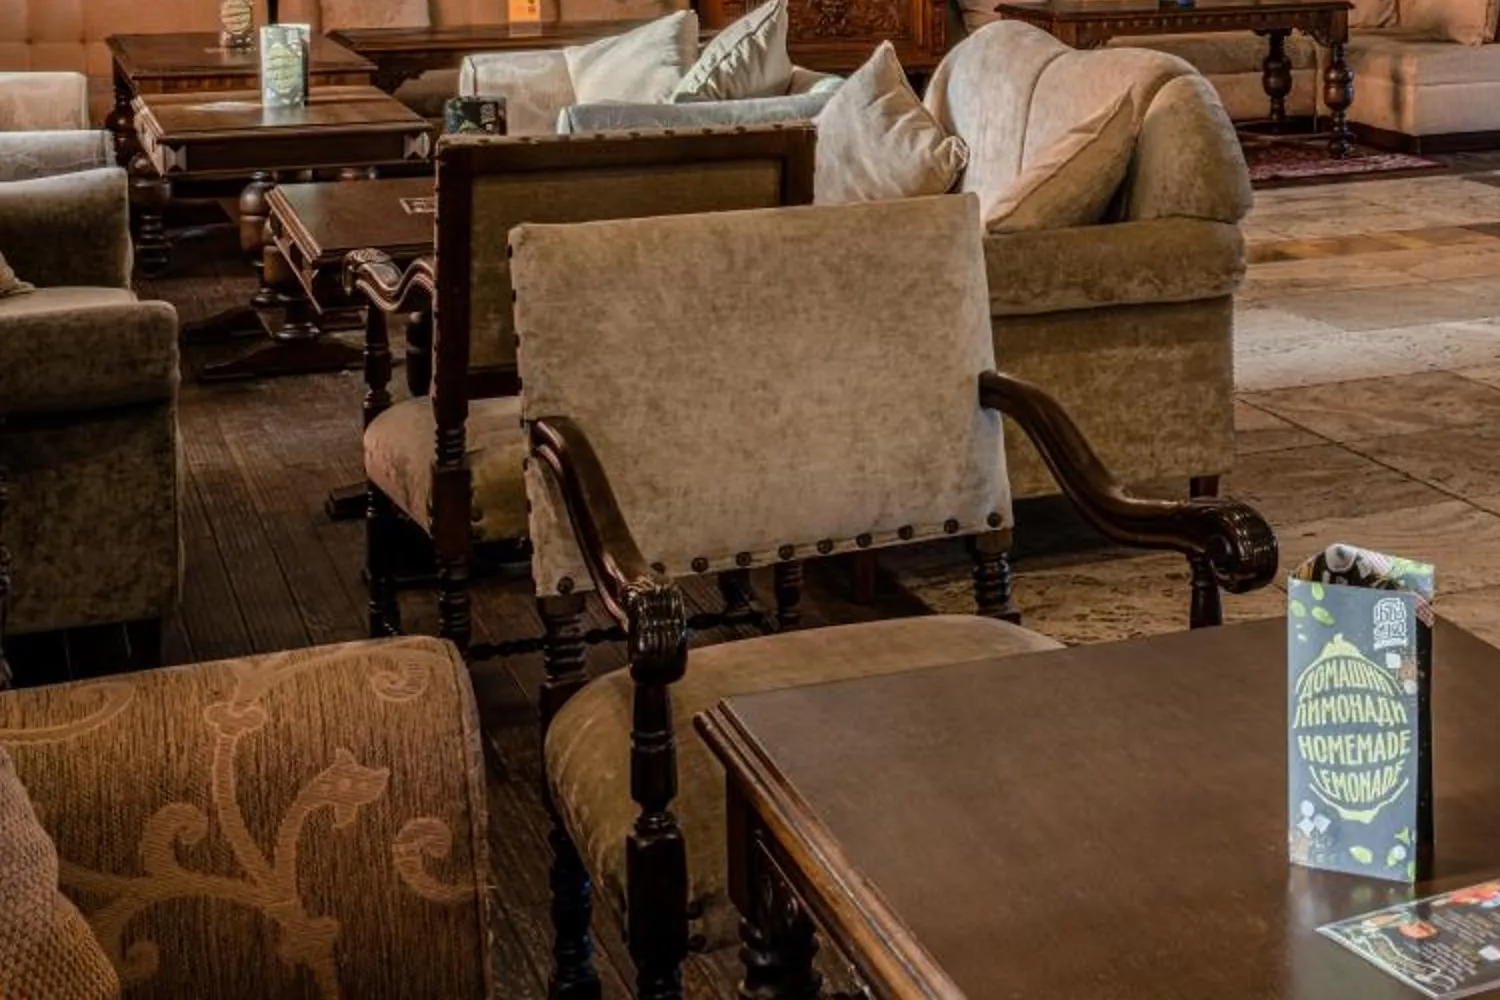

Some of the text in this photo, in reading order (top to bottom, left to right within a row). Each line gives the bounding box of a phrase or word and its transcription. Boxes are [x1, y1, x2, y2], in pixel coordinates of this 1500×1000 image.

[1293, 694, 1408, 728] ЛИМОНАДИ
[1298, 730, 1412, 765] HOMEMADE
[1308, 759, 1406, 803] LEMONADE
